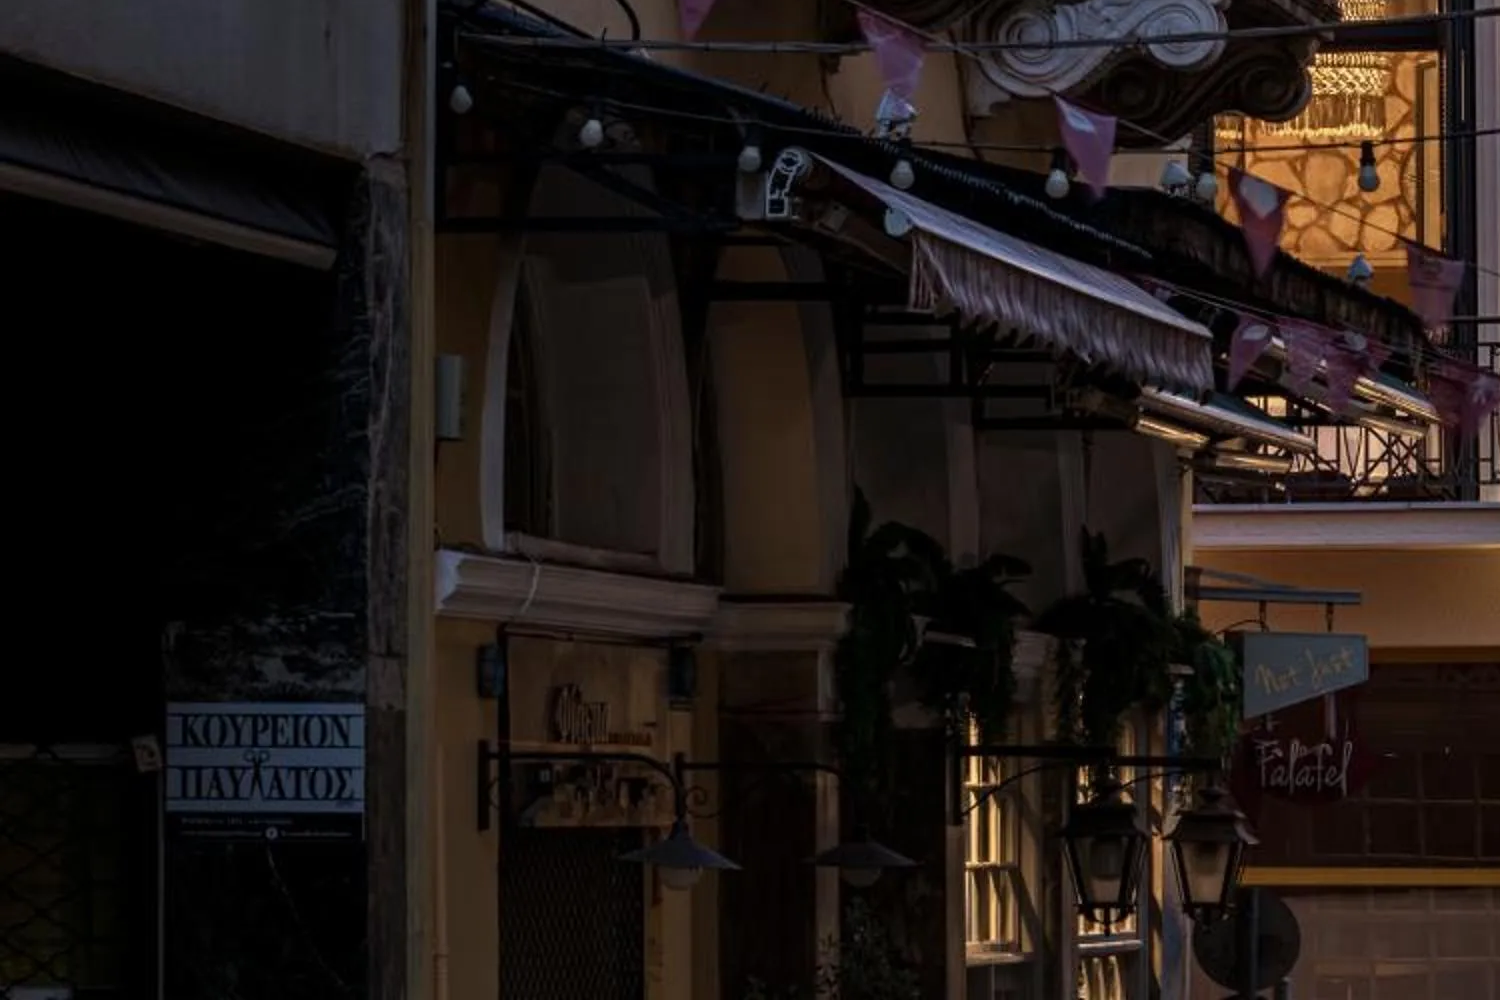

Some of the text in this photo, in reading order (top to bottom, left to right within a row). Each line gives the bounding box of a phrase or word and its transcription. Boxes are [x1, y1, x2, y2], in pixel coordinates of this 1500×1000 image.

[1254, 663, 1297, 695] Not
[182, 714, 350, 747] ΚΟΥΡΕΙΟΝ
[1254, 737, 1353, 797] Falafel
